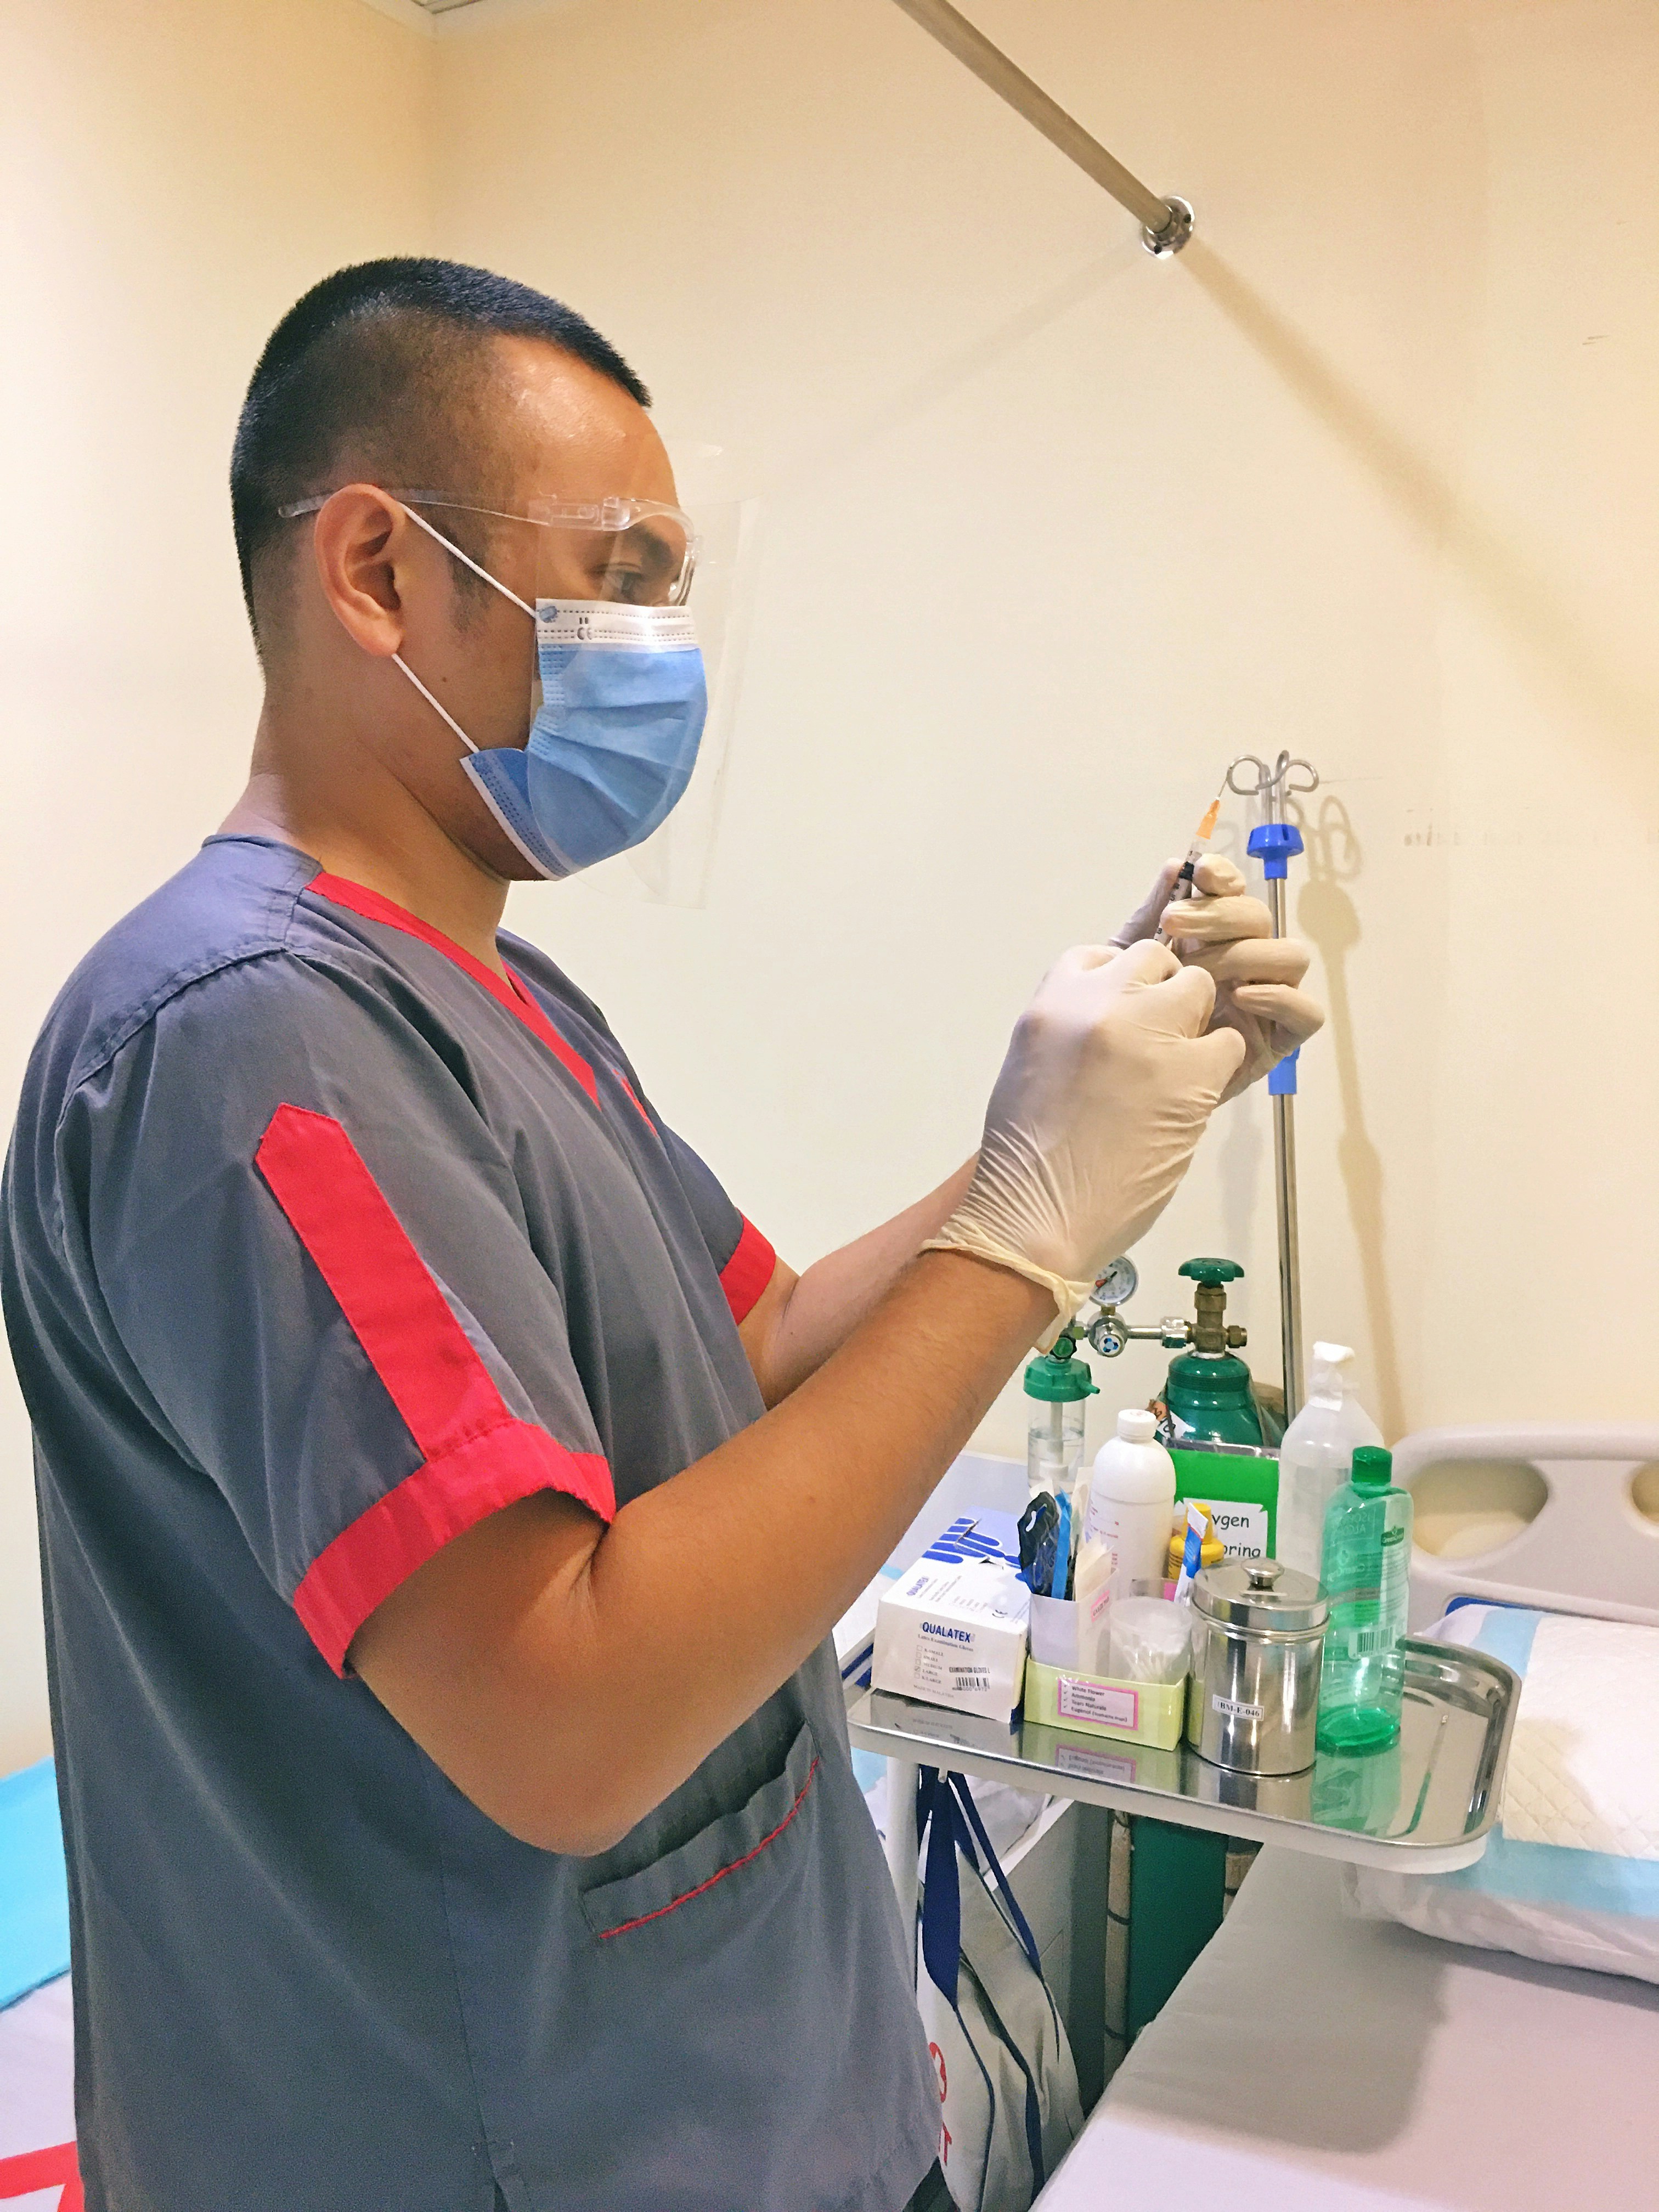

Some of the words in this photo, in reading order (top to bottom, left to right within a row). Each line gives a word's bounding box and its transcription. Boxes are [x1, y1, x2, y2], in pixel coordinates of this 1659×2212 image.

[922, 1622, 972, 1643] QUALATEX
[1071, 1692, 1096, 1702] Ammonia
[1071, 1706, 1091, 1714] Eugenol
